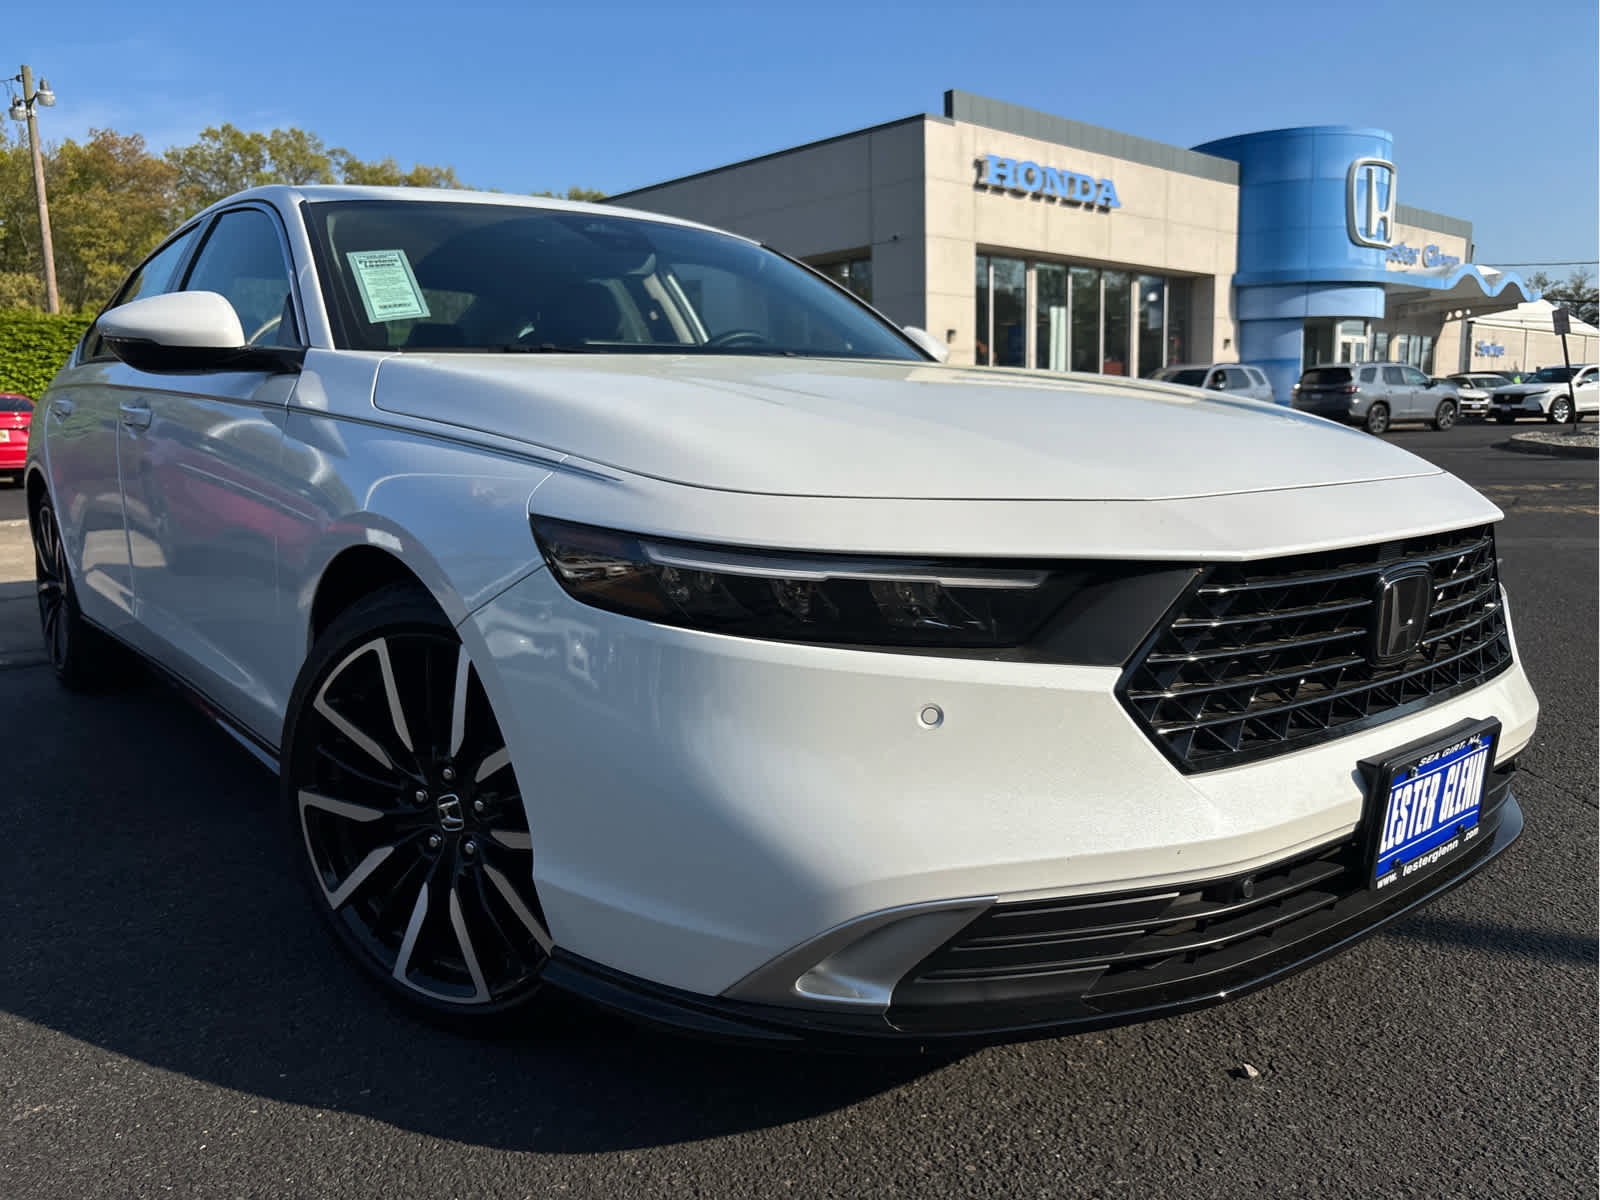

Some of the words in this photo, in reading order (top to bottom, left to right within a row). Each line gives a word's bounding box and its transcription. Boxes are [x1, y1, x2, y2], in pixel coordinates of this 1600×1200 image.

[985, 153, 1121, 209] HONDA
[1418, 752, 1441, 767] SEA
[1379, 772, 1442, 855] LESTER
[1438, 749, 1488, 824] GLENN
[1402, 838, 1459, 877] lesterglenn
[1463, 826, 1480, 843] .com
